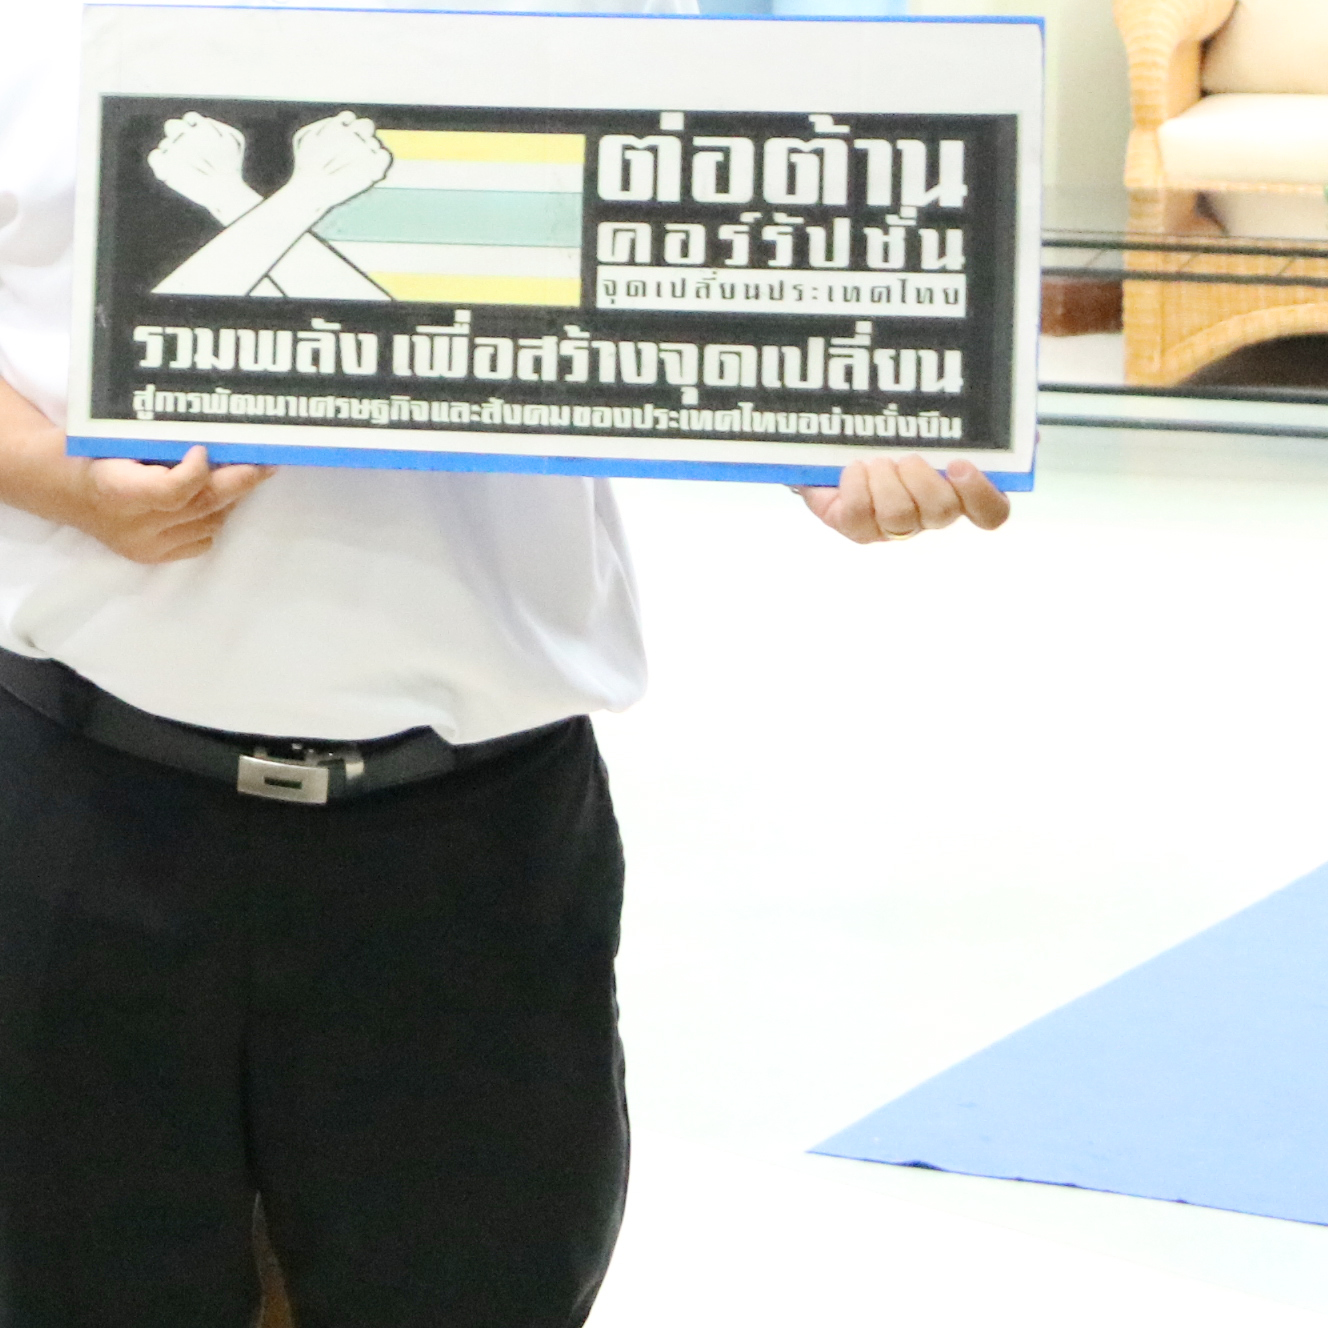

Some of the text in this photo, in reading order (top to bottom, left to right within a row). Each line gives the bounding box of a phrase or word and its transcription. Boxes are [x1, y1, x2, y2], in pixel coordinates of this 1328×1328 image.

[597, 112, 968, 208] ต่อต้าน
[132, 317, 379, 376] รวมพลัง
